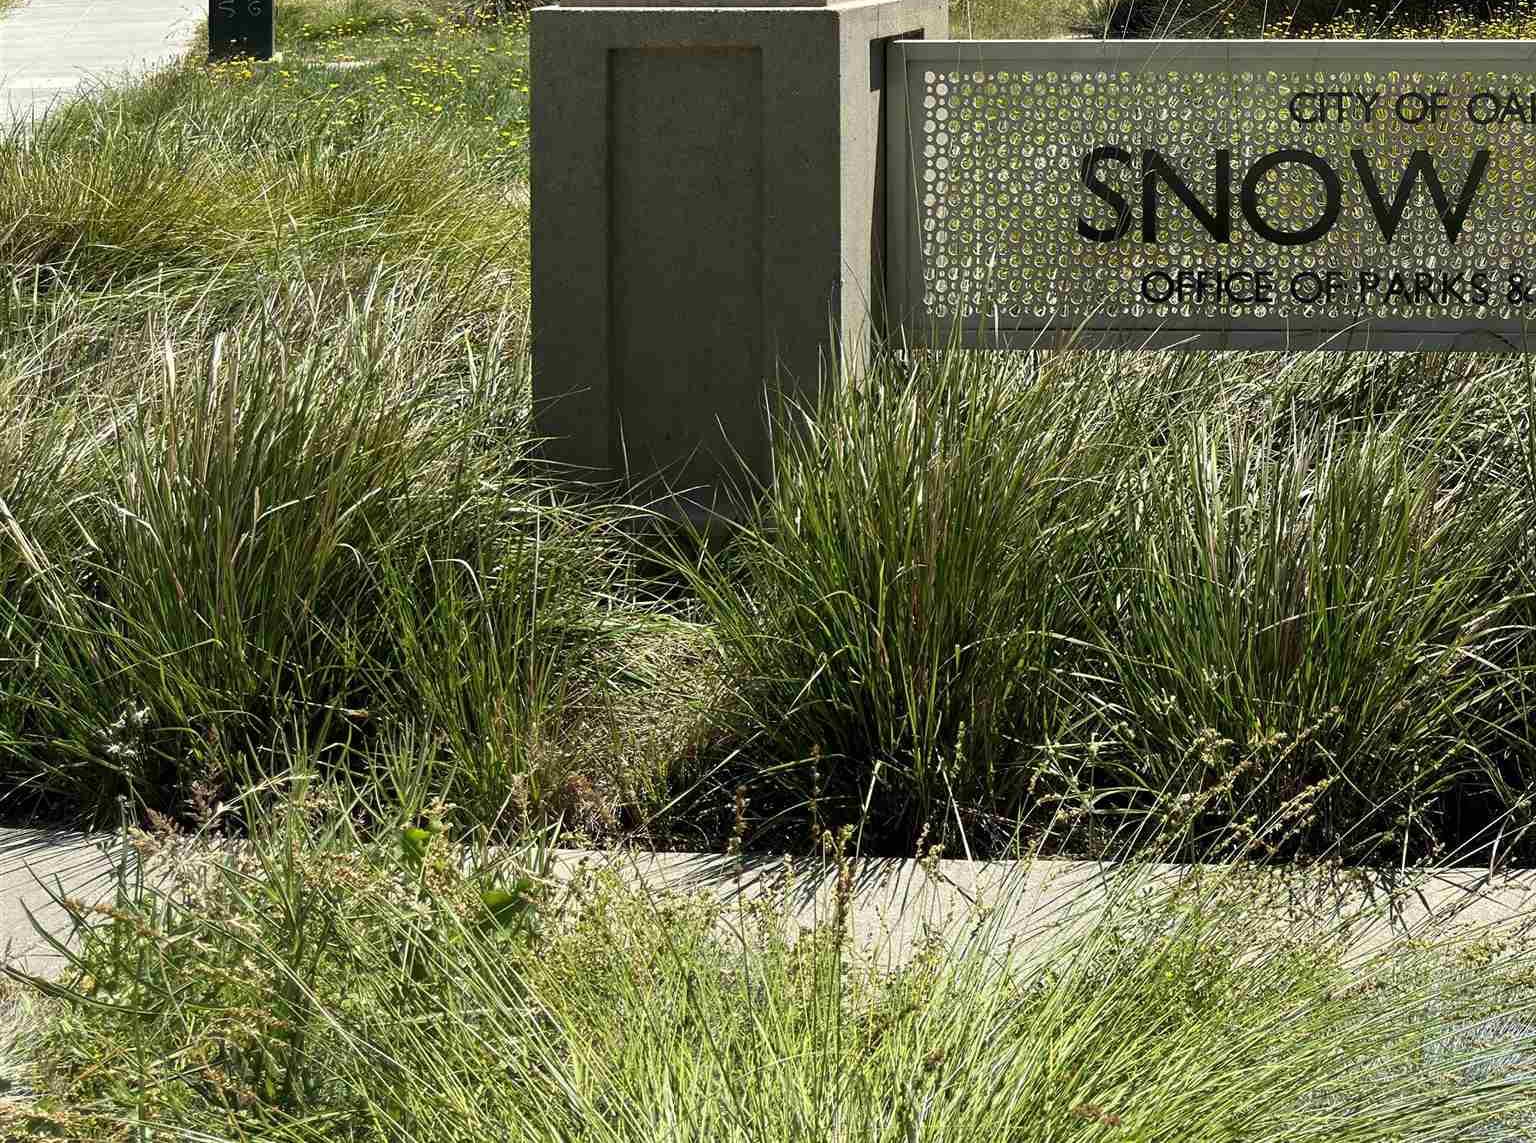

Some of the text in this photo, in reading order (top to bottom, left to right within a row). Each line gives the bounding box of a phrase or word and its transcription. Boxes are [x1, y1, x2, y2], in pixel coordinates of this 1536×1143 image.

[1289, 92, 1381, 124] CITY
[1395, 92, 1449, 124] OF
[1077, 145, 1491, 247] SNOW
[1141, 271, 1273, 305] OFFICE
[1291, 271, 1350, 305] OF
[1364, 271, 1489, 307] PARKS
[1505, 274, 1536, 306] &
